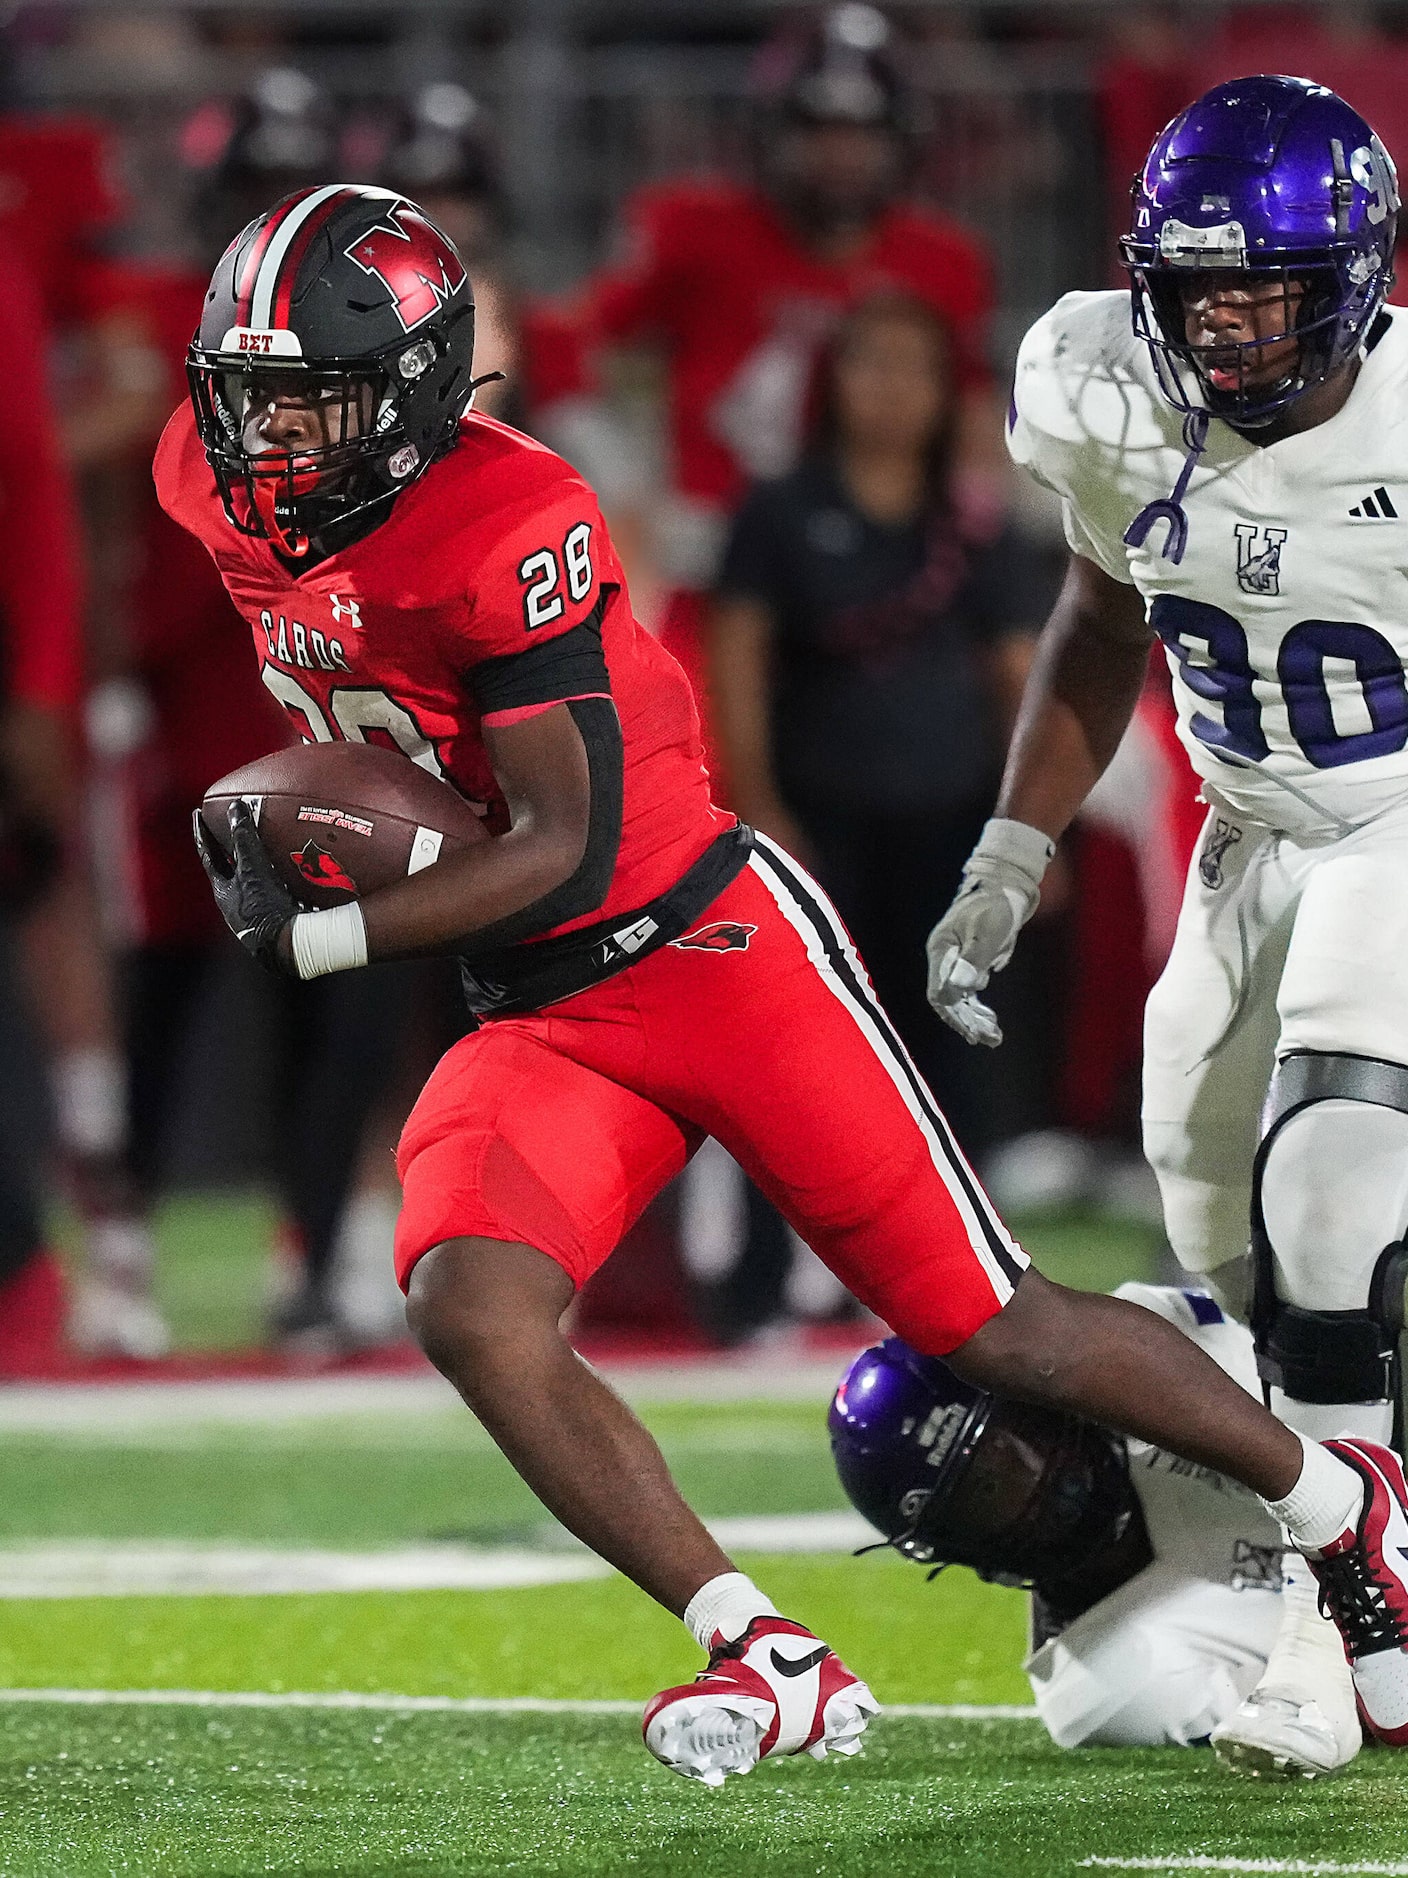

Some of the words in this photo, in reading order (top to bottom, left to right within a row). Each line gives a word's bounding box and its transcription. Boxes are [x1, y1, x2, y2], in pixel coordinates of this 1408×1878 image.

[343, 199, 468, 334] M
[517, 521, 593, 632] 28
[260, 609, 354, 674] CARDS
[297, 811, 336, 824] ISSUE
[335, 817, 373, 837] TEAM
